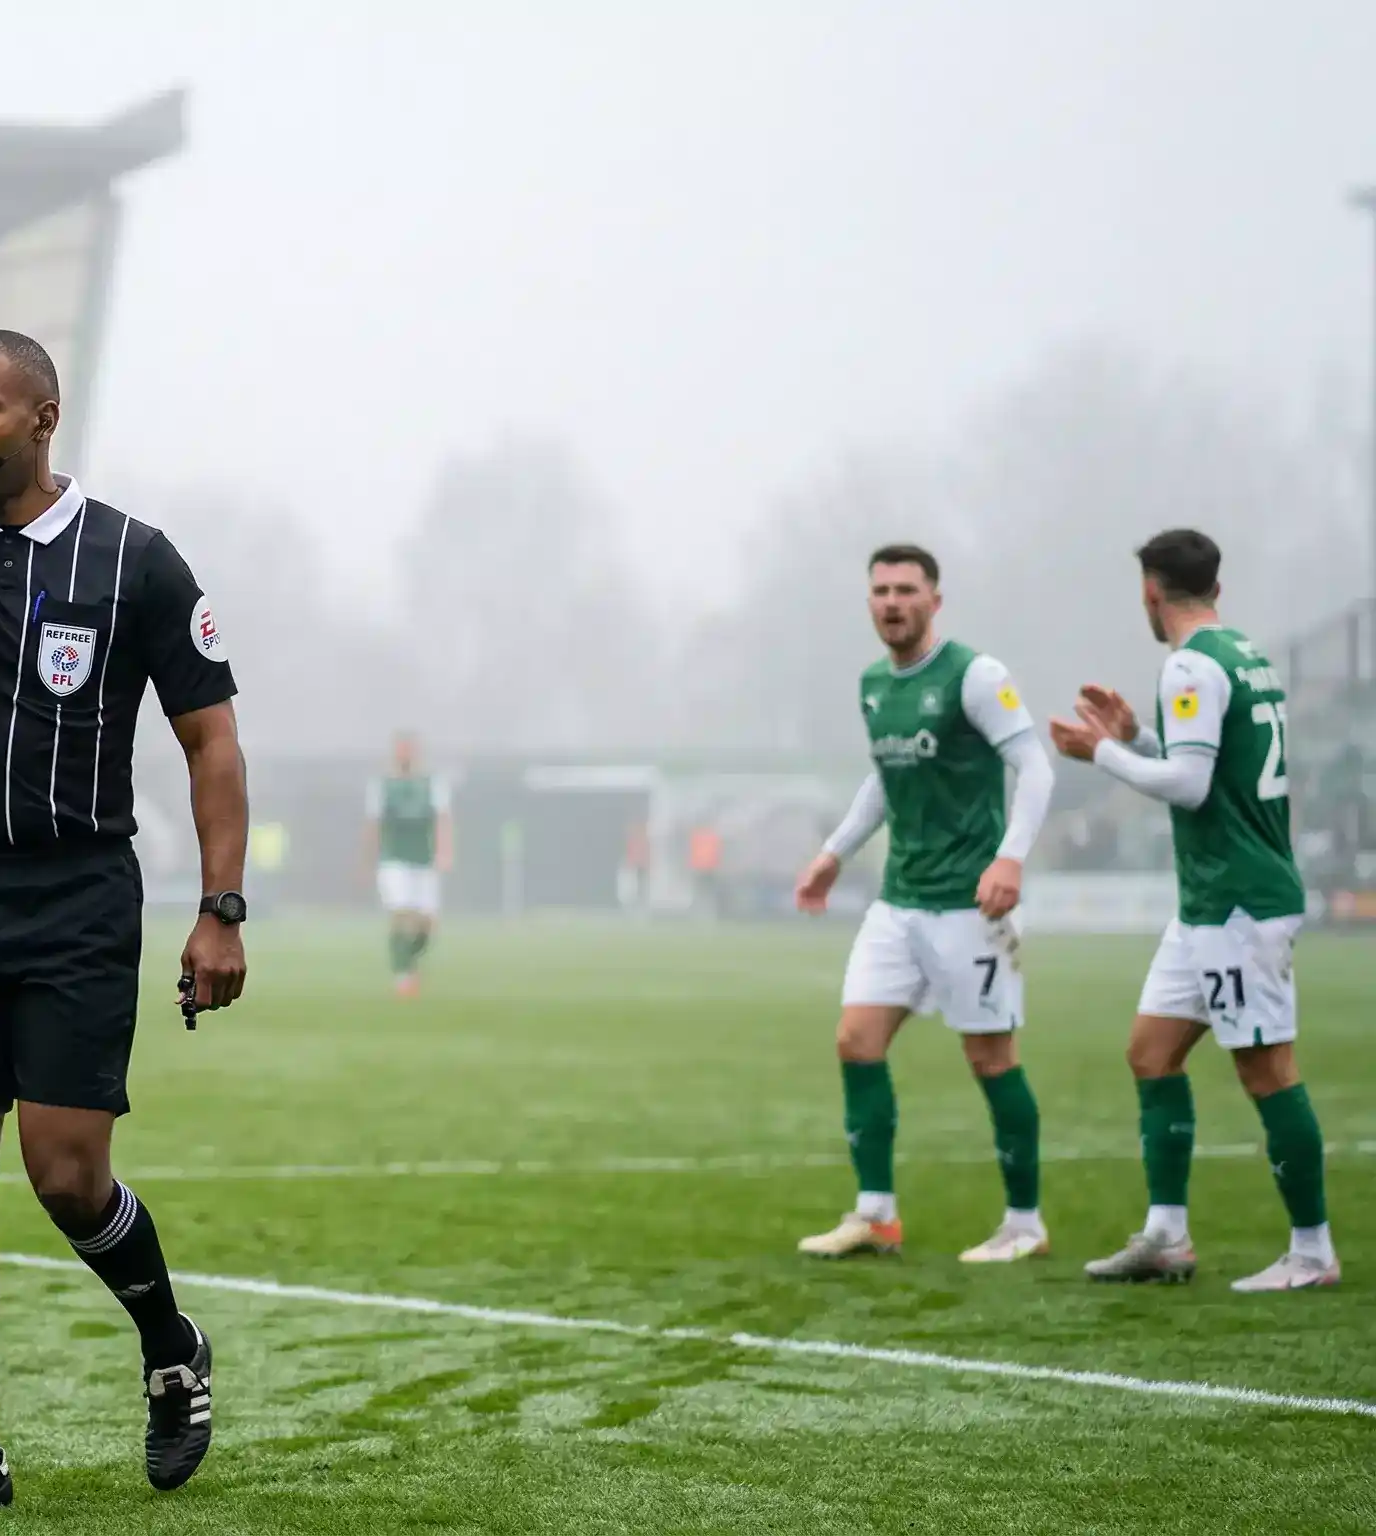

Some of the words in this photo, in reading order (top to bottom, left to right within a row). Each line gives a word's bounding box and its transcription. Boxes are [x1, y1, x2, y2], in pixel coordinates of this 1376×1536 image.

[45, 629, 91, 643] REFEREE
[51, 674, 74, 687] EFL
[1251, 702, 1288, 801] 2
[973, 956, 998, 996] 7
[1203, 966, 1246, 1009] 21
